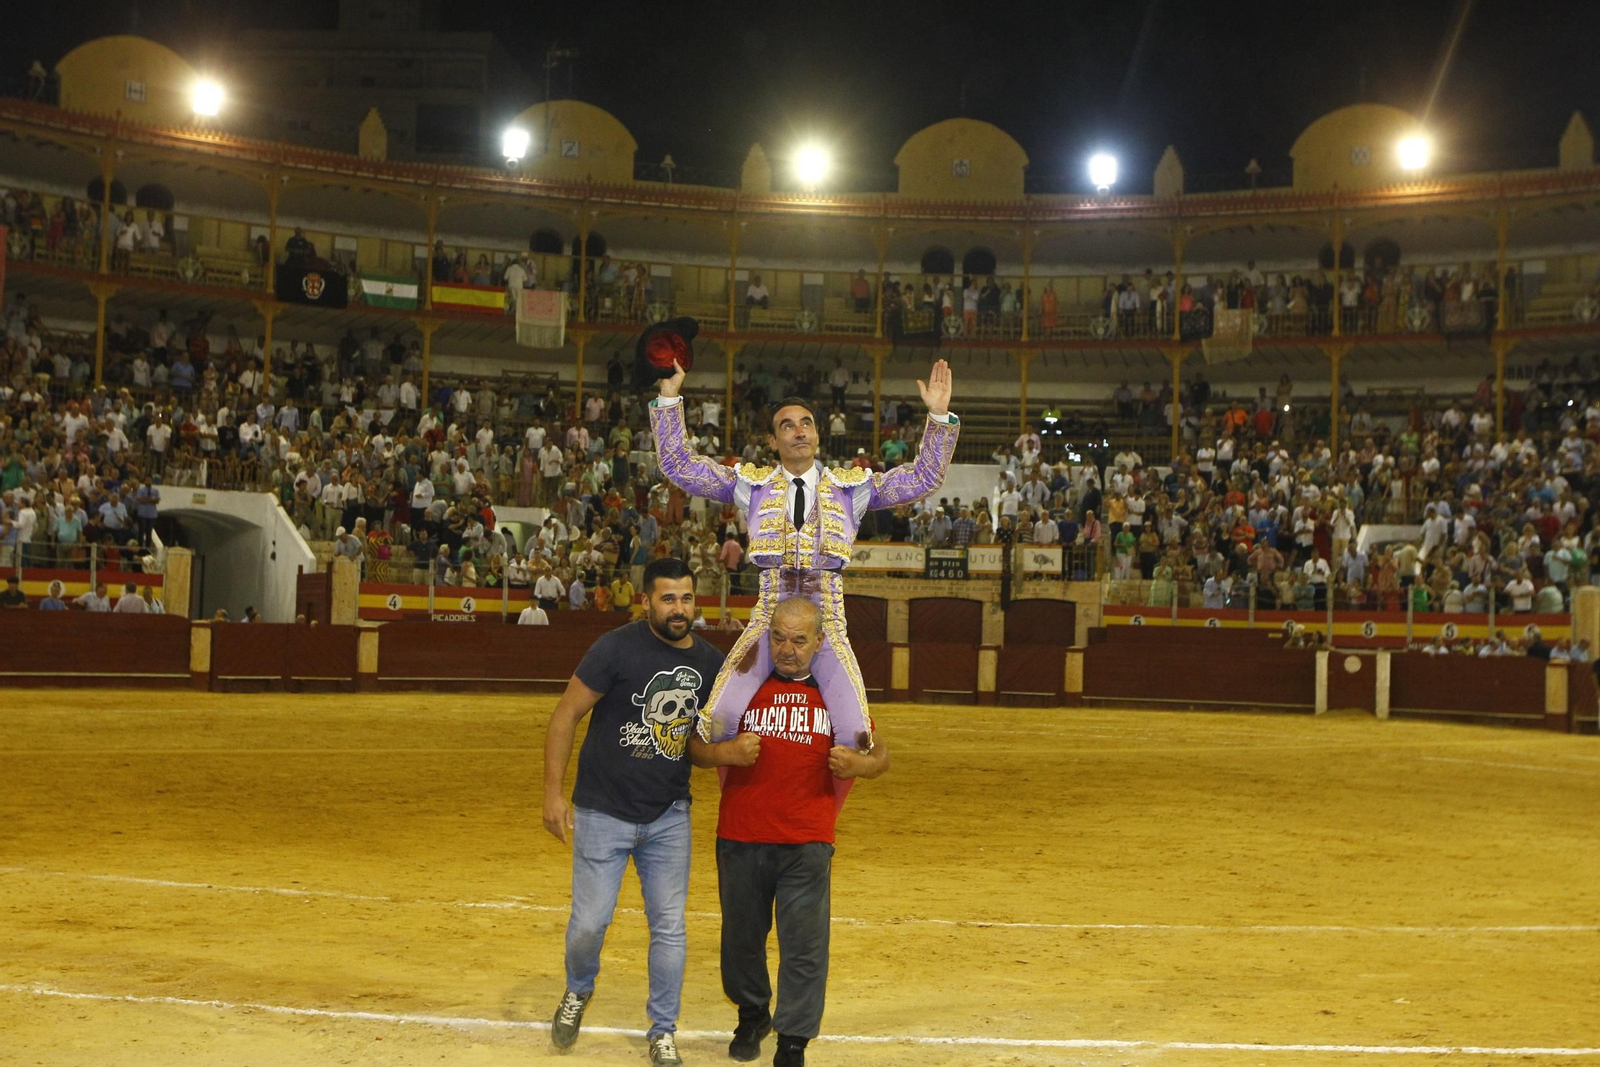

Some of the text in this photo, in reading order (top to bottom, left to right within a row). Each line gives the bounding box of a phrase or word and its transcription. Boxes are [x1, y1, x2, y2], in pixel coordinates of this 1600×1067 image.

[388, 595, 398, 609] 4
[463, 598, 472, 612] 4
[431, 613, 476, 623] PICADORES
[1364, 622, 1373, 636] 5
[1446, 624, 1455, 638] 5
[774, 693, 809, 705] HOTEL
[743, 706, 787, 732] PALACIO
[789, 706, 810, 732] DEL
[619, 721, 650, 735] Skate
[619, 734, 652, 747] Skull
[758, 730, 813, 746] SANTANDER
